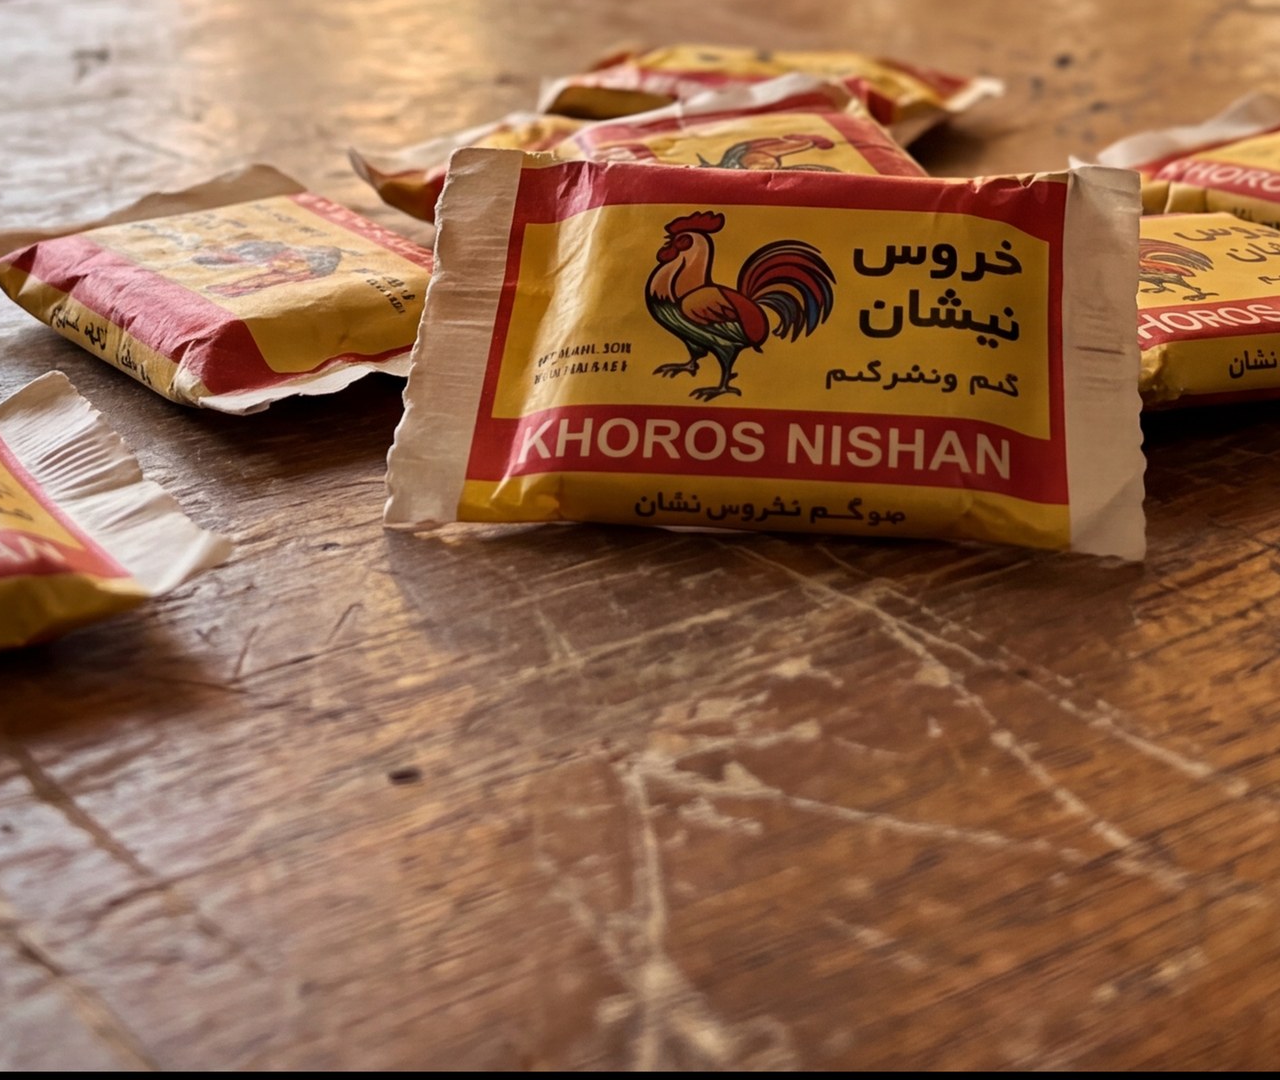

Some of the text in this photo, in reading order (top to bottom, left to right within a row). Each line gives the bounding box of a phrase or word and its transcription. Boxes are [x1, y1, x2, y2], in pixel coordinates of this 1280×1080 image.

[853, 239, 1023, 282] خروس
[859, 288, 1020, 349] نیشان
[1228, 349, 1279, 380] نشان
[518, 417, 1011, 480] KHOROS NISHAN
[634, 491, 701, 518] نشان
